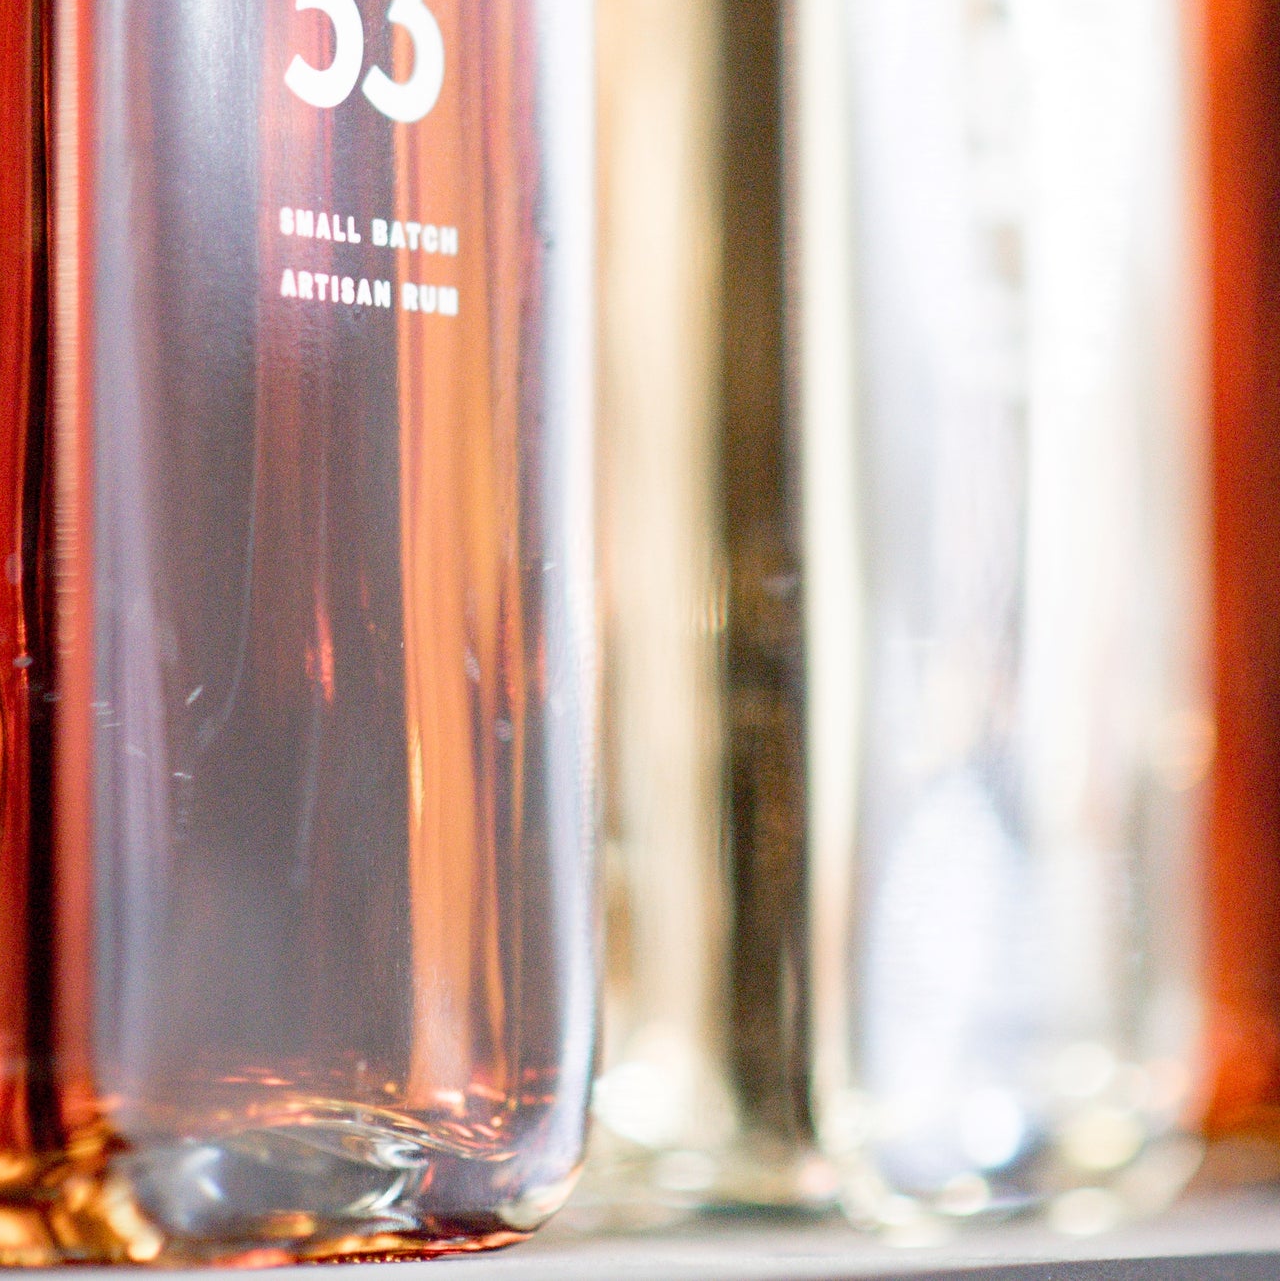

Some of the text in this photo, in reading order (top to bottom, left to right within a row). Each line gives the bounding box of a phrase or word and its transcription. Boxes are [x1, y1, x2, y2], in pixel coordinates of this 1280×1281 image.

[279, 206, 459, 256] SMALL BATCH
[280, 268, 459, 317] ARTISAN RUM
